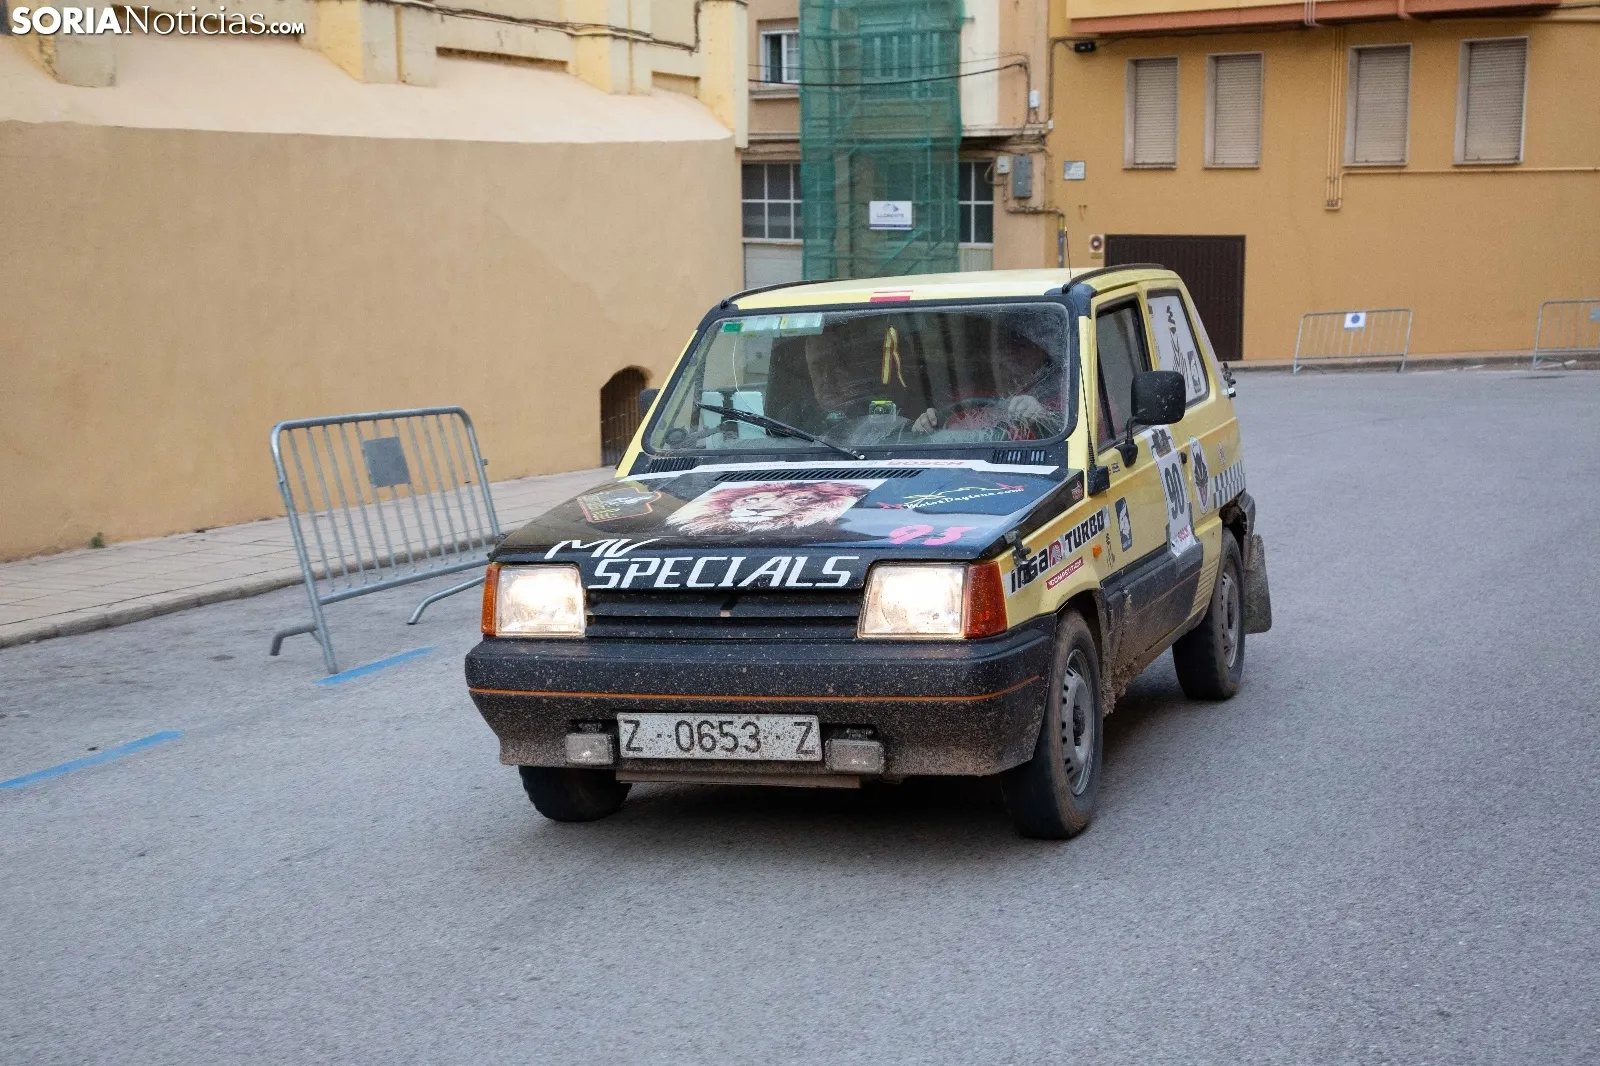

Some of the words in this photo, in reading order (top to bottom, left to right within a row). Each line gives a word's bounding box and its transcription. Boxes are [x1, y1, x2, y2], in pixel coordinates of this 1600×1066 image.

[1164, 462, 1185, 520] 90
[1064, 509, 1105, 553] TURBO
[588, 556, 860, 588] SPECIALS
